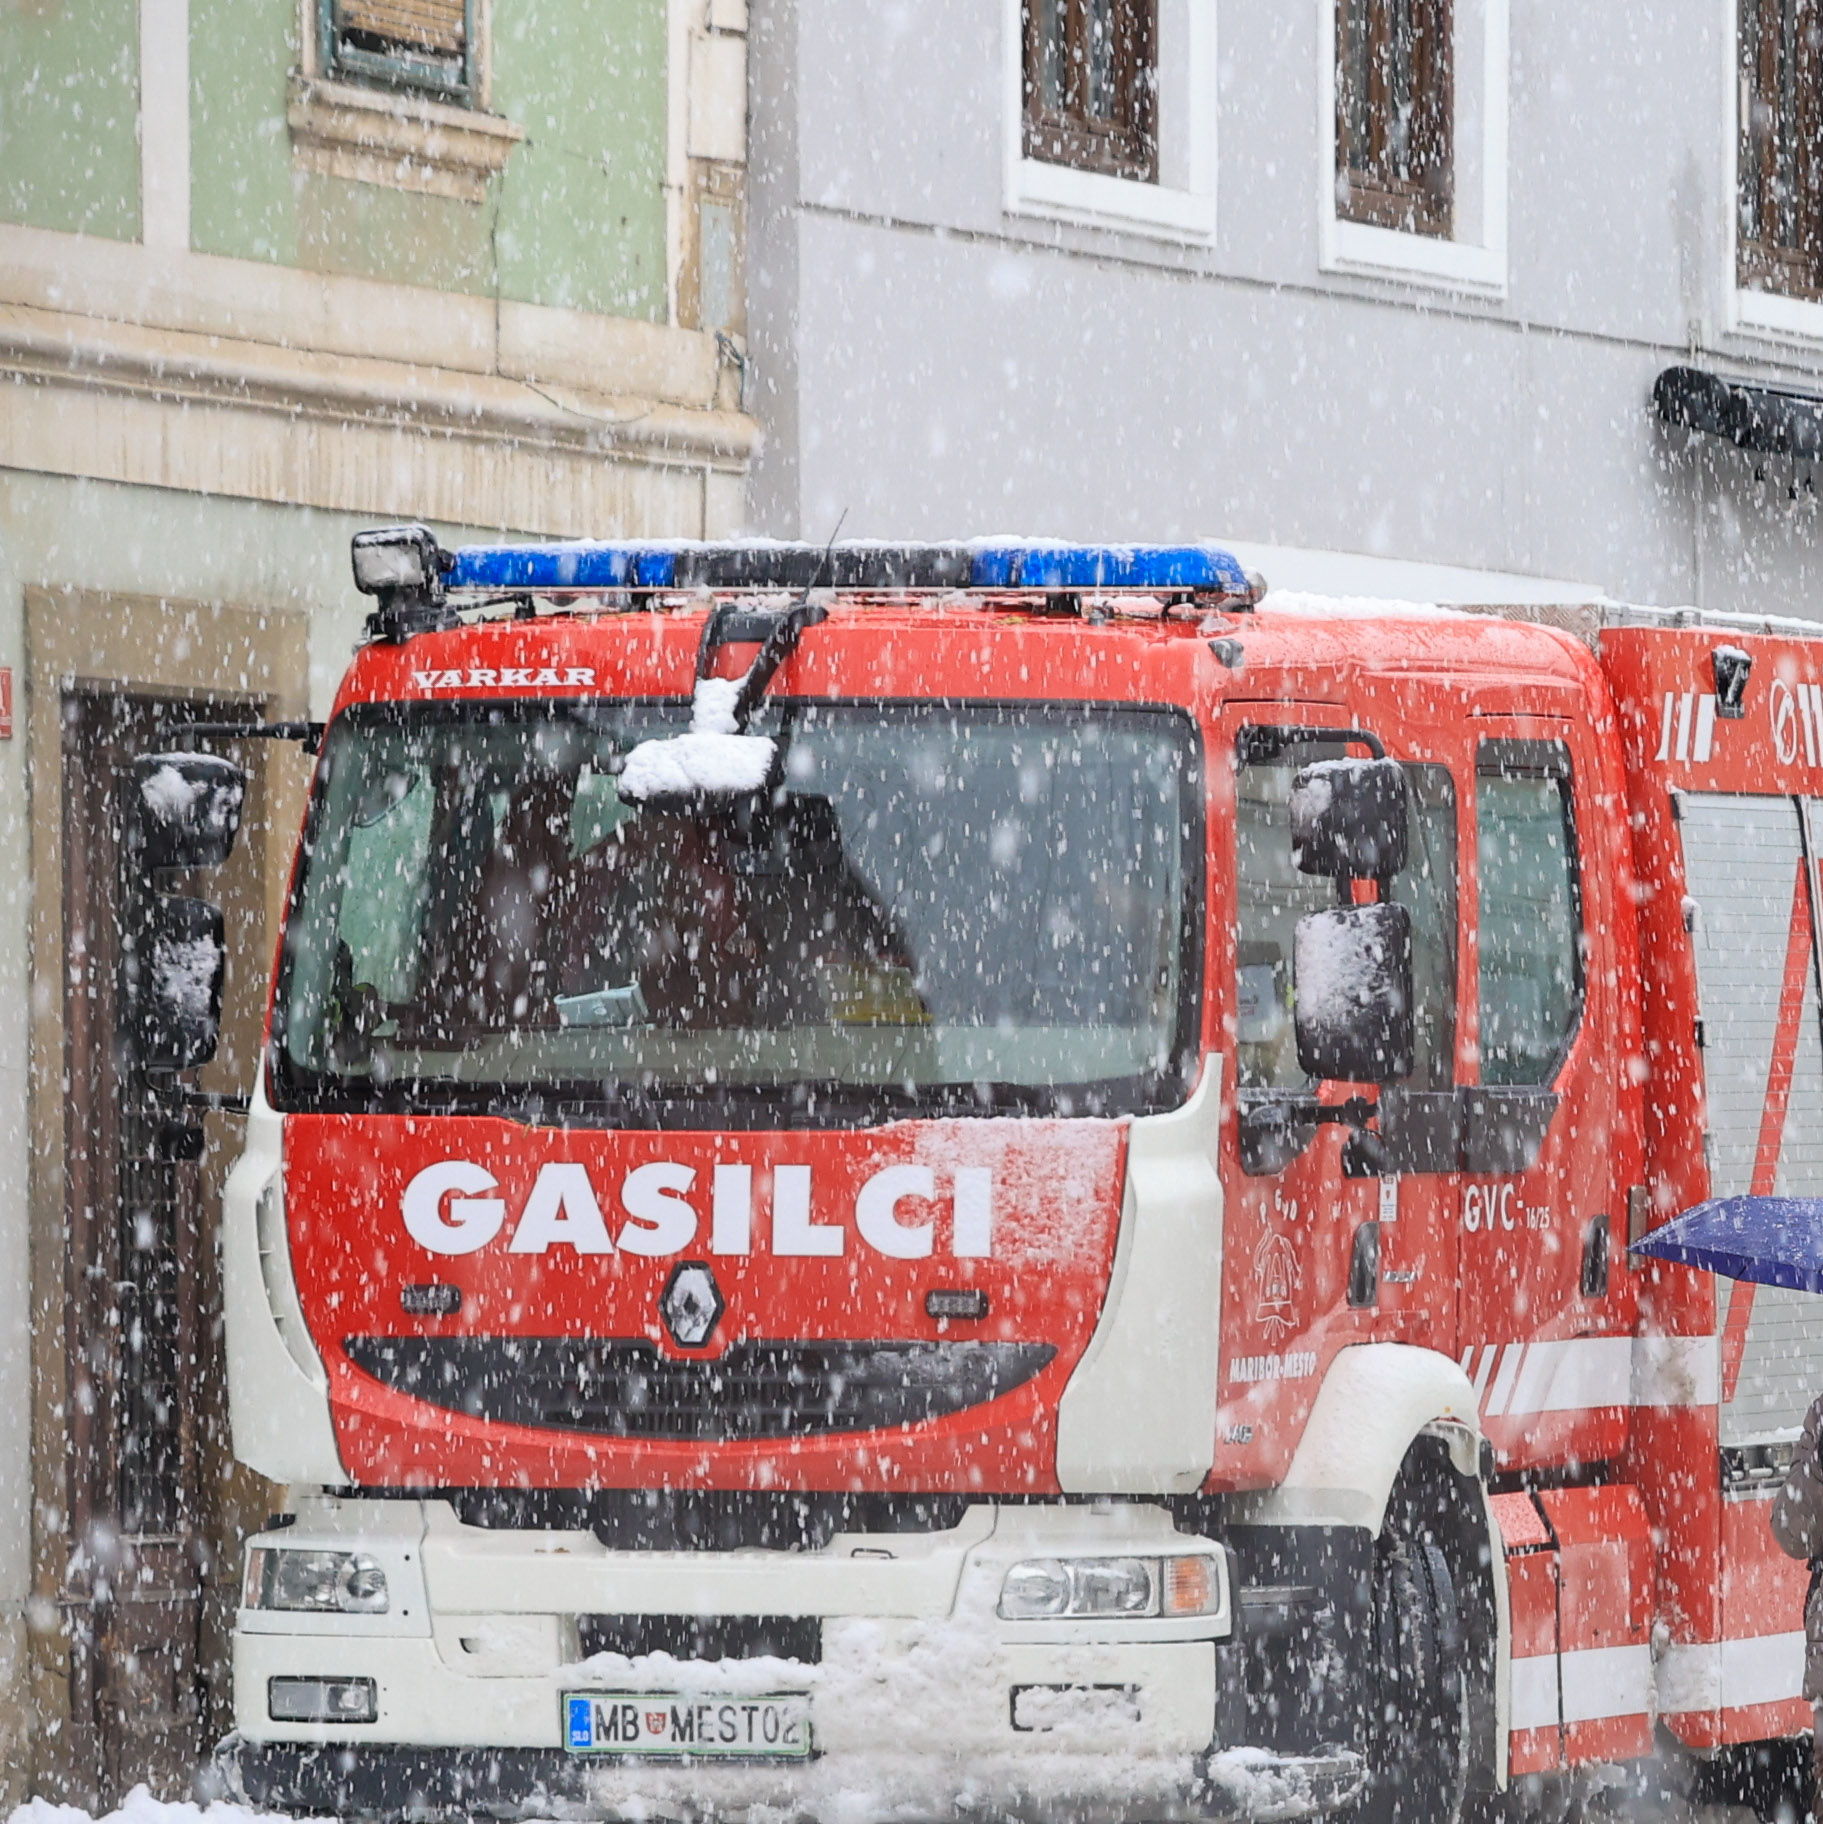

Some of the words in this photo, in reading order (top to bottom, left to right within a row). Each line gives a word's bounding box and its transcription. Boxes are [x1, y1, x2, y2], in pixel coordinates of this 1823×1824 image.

[411, 667, 596, 690] VARKAR
[401, 1160, 993, 1259] GASILCI
[594, 1703, 641, 1742] MB
